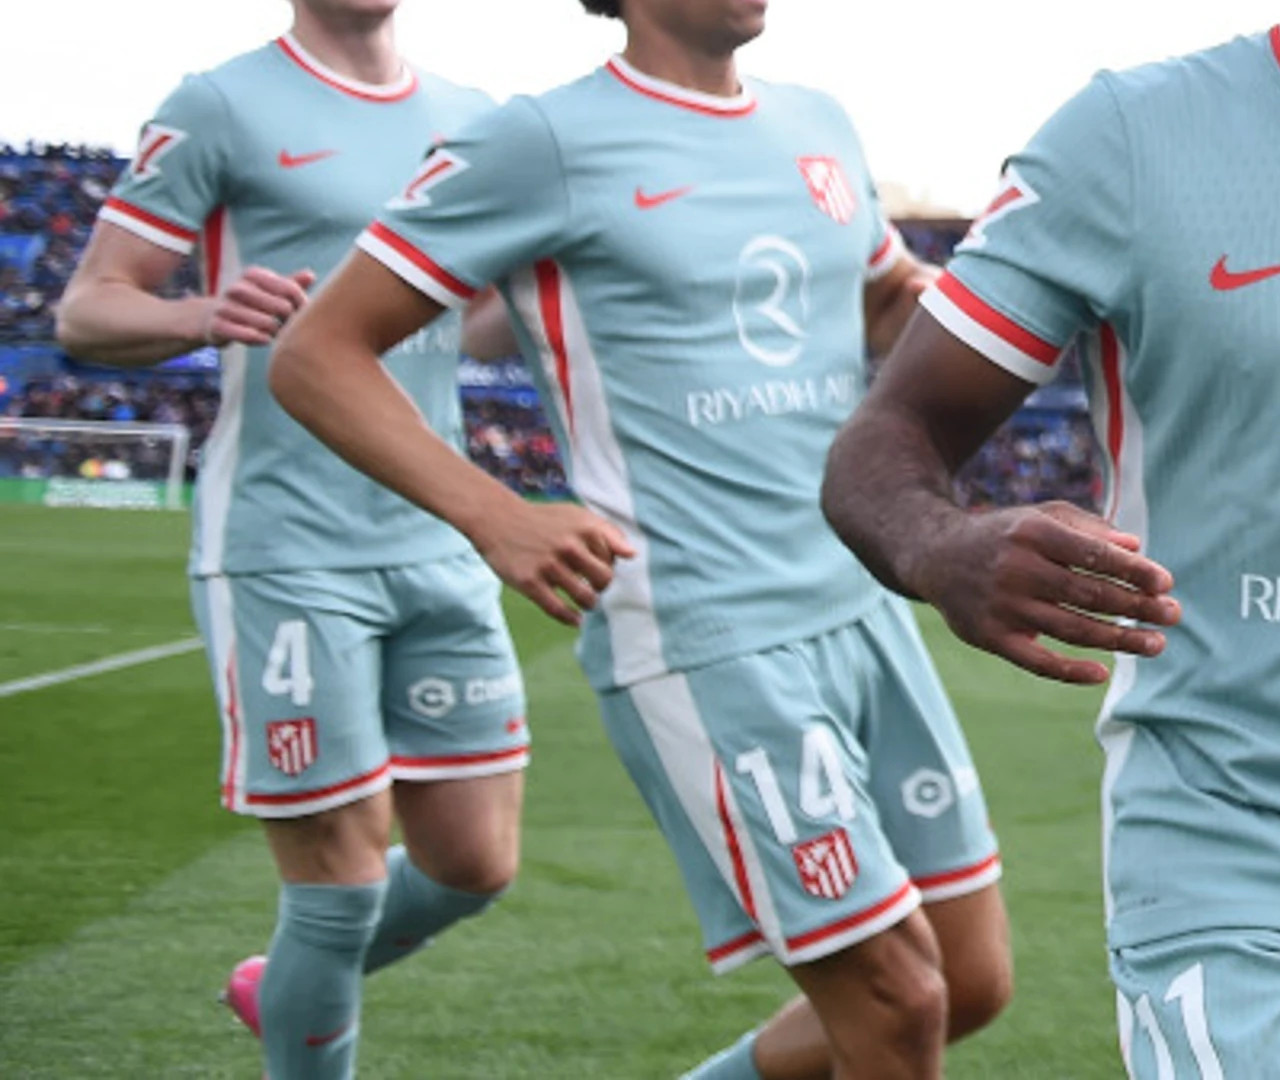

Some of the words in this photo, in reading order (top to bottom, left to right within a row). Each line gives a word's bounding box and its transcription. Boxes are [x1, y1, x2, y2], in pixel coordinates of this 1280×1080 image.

[687, 379, 816, 426] RIYADH
[262, 620, 314, 706] 4
[735, 724, 856, 844] 14
